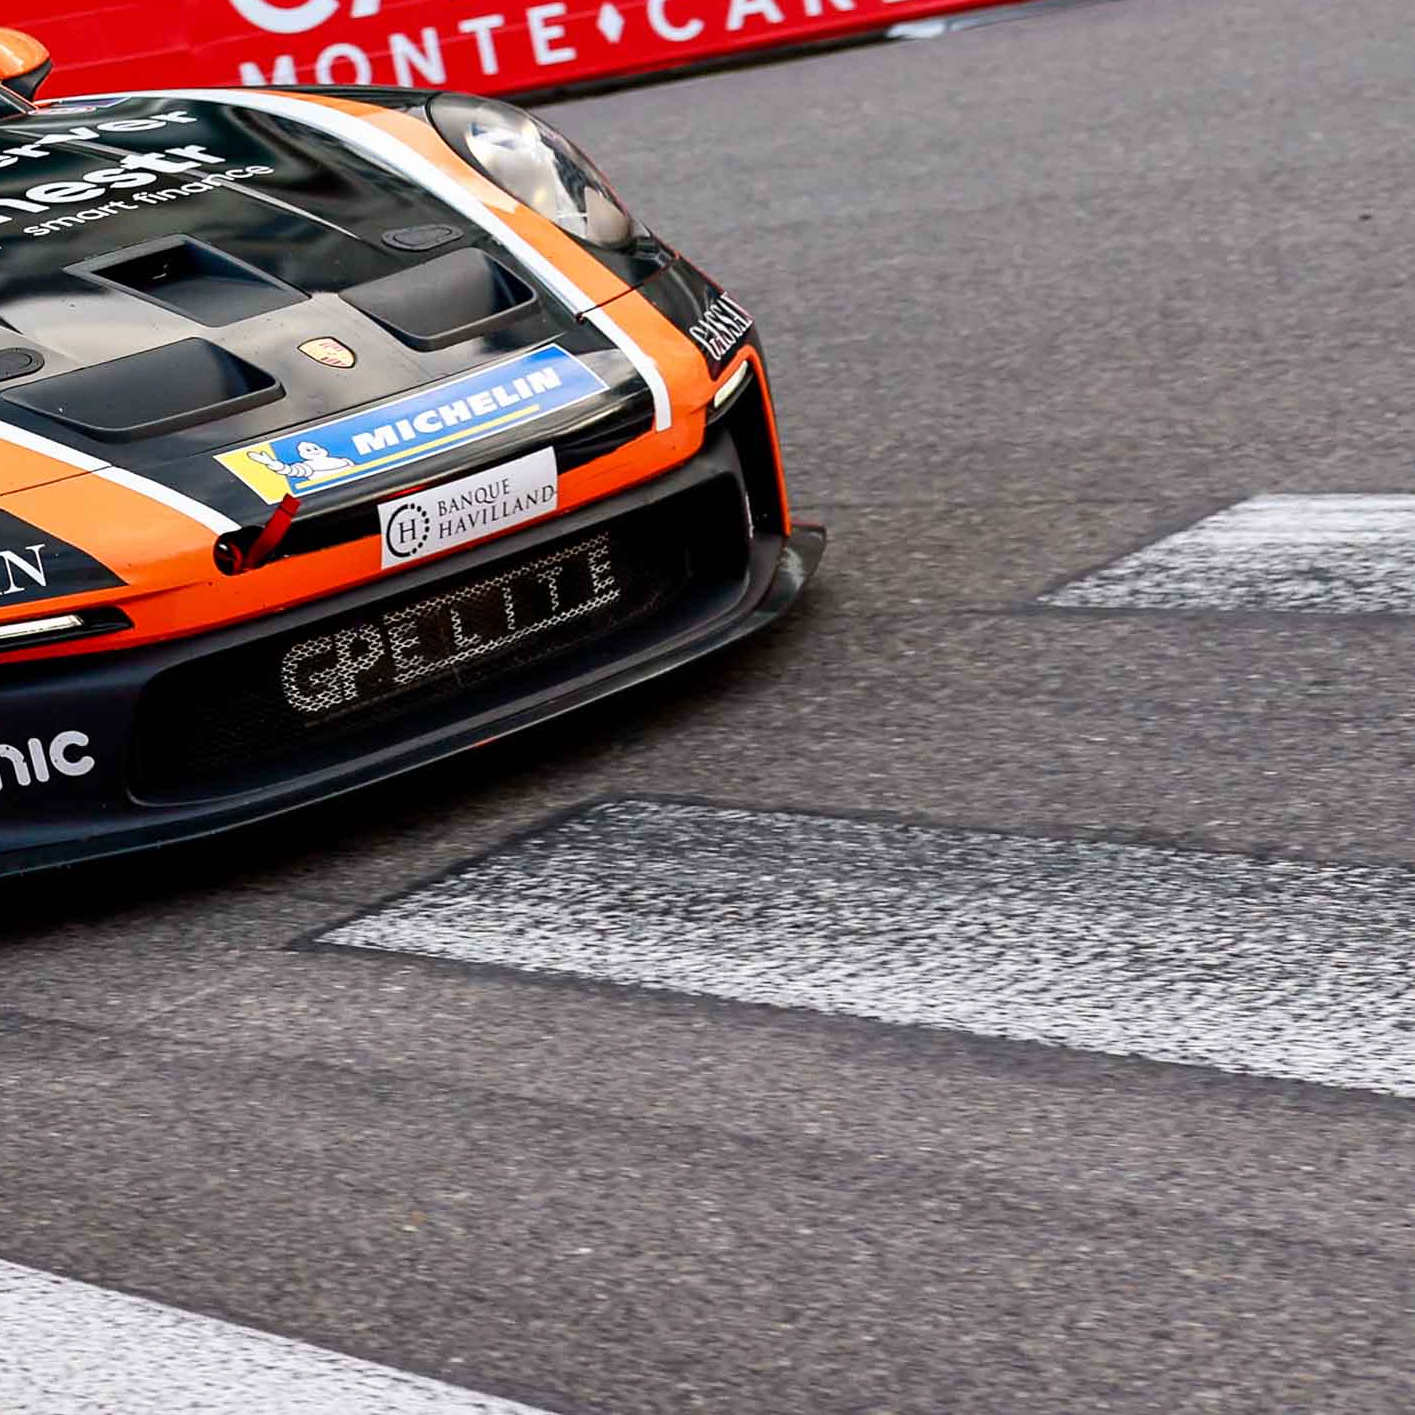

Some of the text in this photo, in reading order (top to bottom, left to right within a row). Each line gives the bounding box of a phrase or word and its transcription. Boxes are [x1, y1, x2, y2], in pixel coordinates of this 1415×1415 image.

[23, 163, 274, 237] smart finance
[350, 366, 562, 456] MICHELIN
[437, 478, 511, 517] BANQUE
[438, 484, 556, 540] HAVILLAND
[397, 521, 418, 544] H
